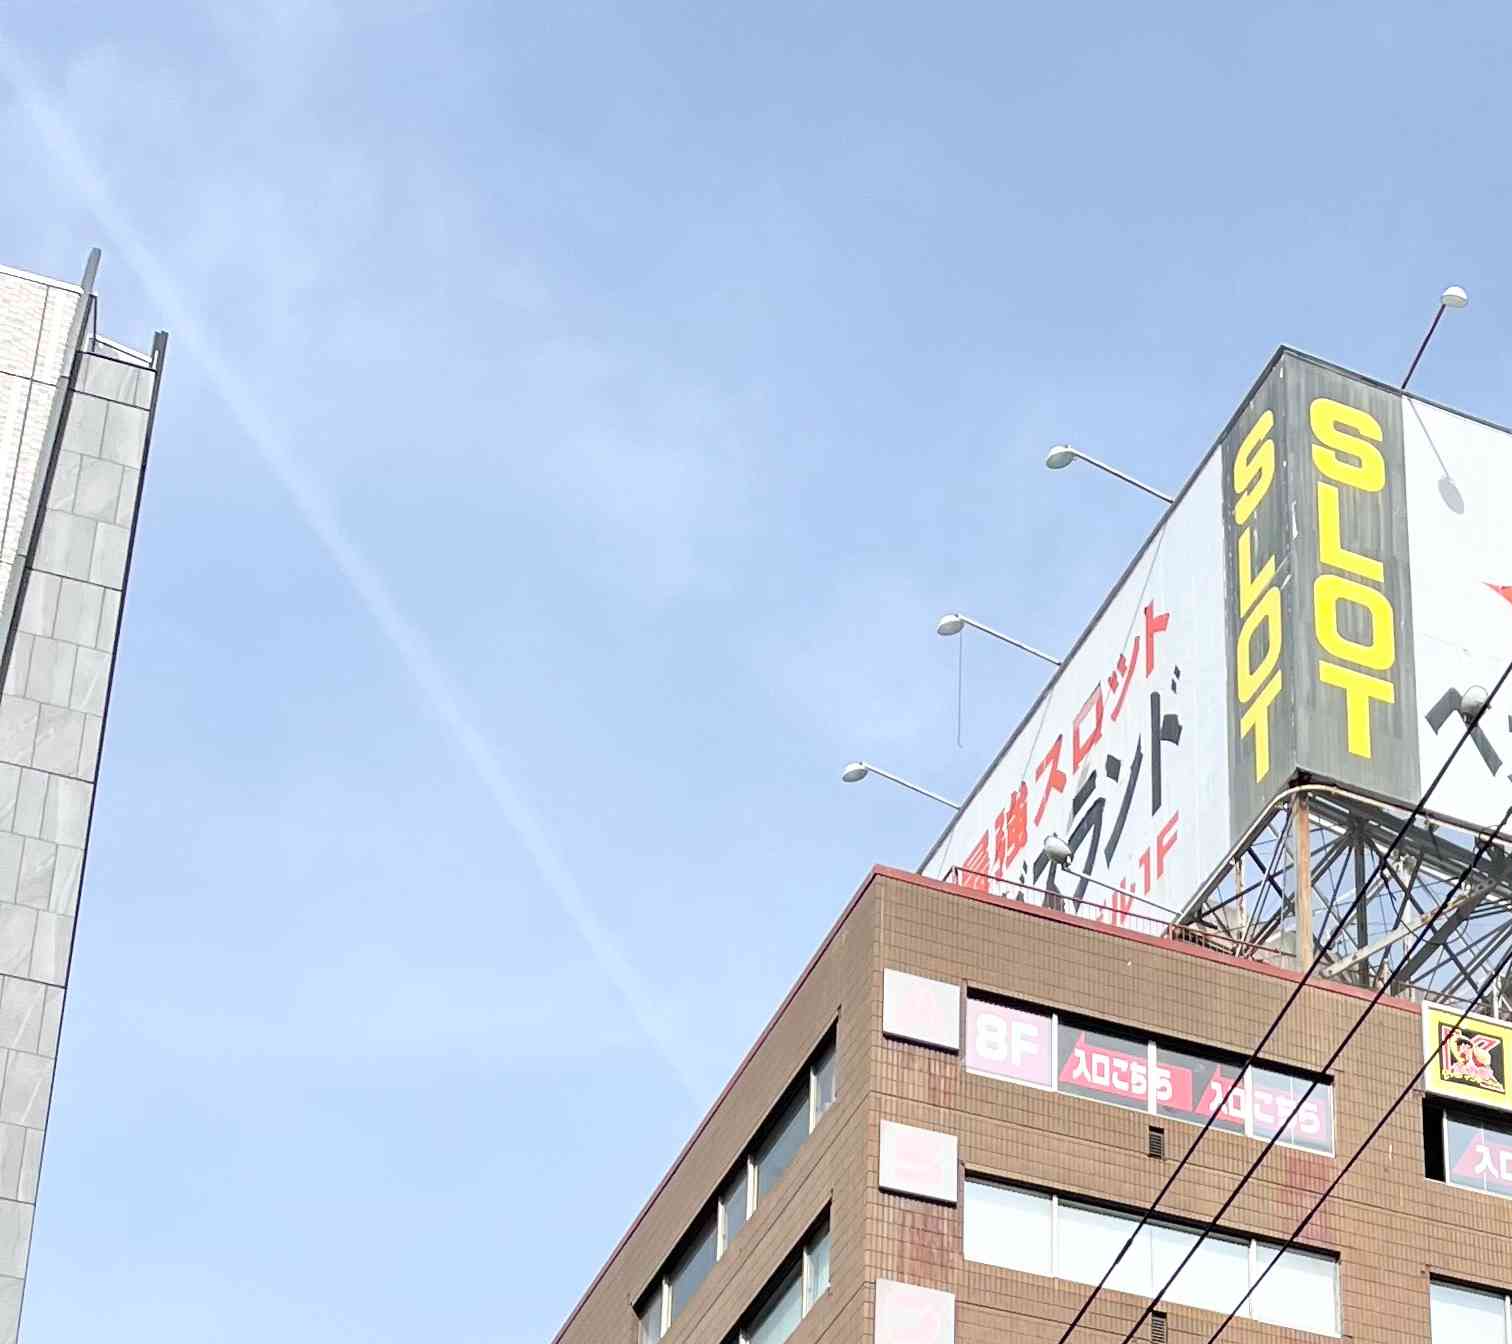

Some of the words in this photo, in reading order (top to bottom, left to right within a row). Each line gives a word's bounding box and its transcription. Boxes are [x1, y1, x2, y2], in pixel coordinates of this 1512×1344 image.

[1232, 409, 1283, 783] SLOT
[1308, 396, 1396, 760] SLOT
[975, 1013, 1041, 1066] 8F
[1073, 1046, 1174, 1101] 入口こちら
